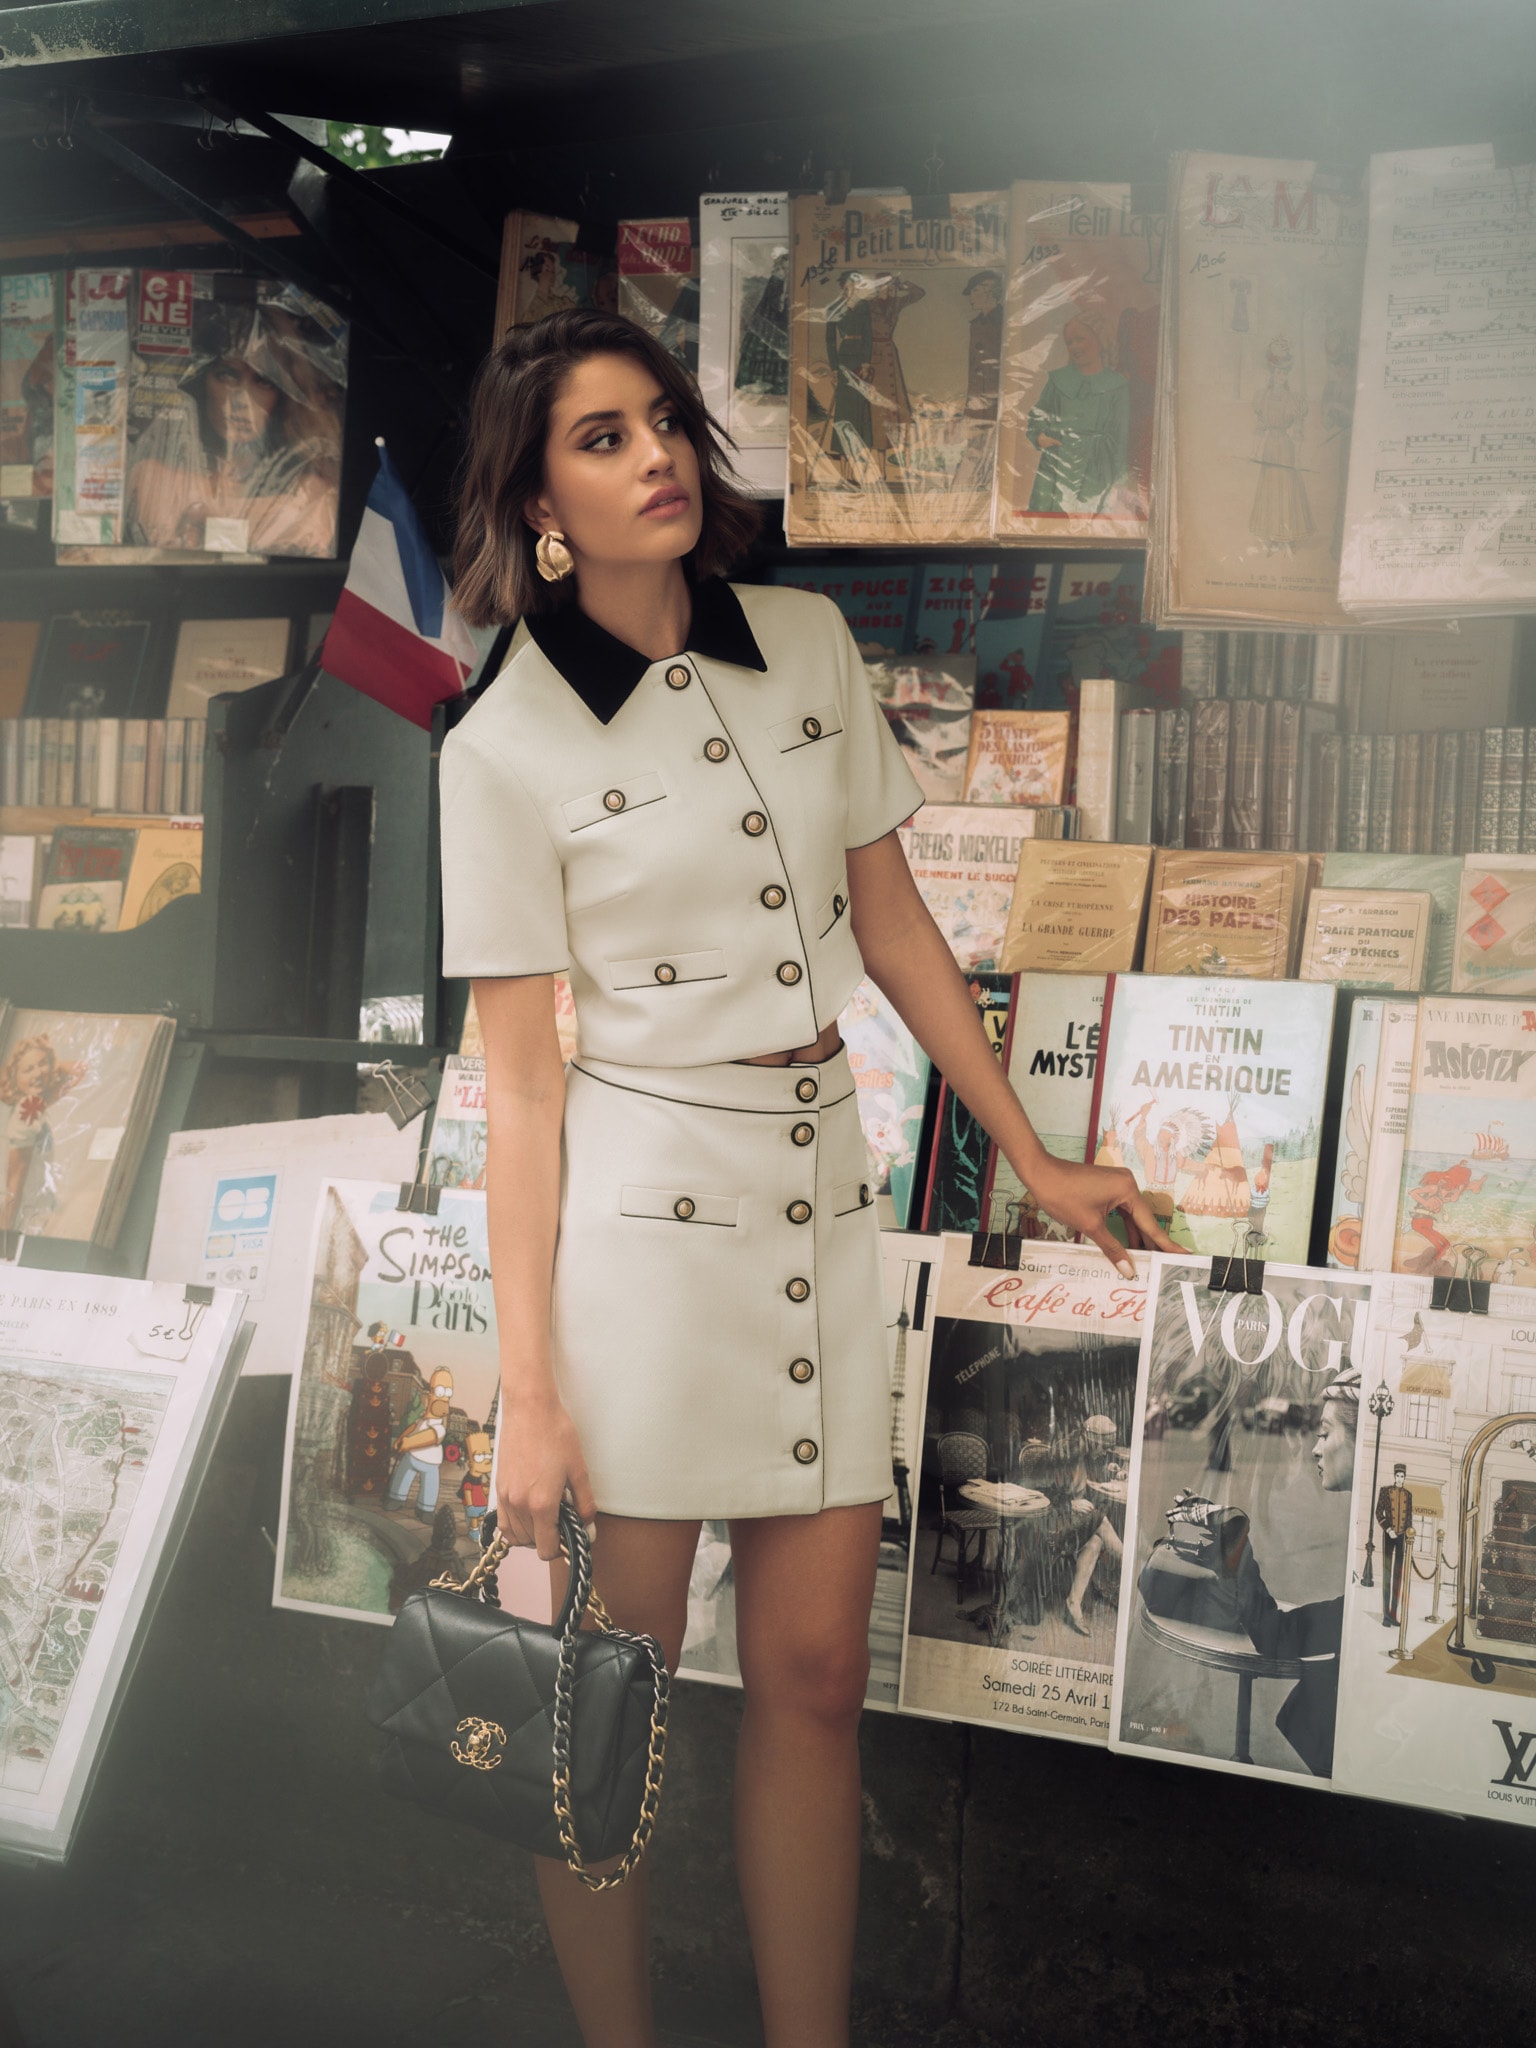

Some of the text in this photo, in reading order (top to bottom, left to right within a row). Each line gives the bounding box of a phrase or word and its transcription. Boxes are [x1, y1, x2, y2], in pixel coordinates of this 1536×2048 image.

[844, 209, 893, 262] Petit
[1190, 251, 1227, 274] 1906
[851, 577, 909, 598] PUCE
[929, 576, 976, 592] ZIG
[1071, 581, 1112, 597] ZIG
[909, 831, 954, 862] PIEDS
[967, 871, 981, 881] LE
[1184, 894, 1258, 910] HISTOIRE
[1162, 907, 1277, 931] DES PAPES
[1021, 921, 1117, 939] LA GRANDE GUERRE
[1357, 926, 1416, 939] PRATIQUE
[1194, 1004, 1242, 1018] TINTIN
[1168, 1024, 1264, 1056] TINTIN
[1204, 1054, 1221, 1064] EN
[458, 1072, 483, 1082] WALT
[1131, 1059, 1292, 1097] AMÉRIQUE
[242, 1238, 264, 1250] VISA
[1020, 1260, 1053, 1274] Saint
[1058, 1263, 1112, 1280] Germain
[10, 1294, 53, 1311] PARIS
[408, 1279, 489, 1335] Paris
[984, 1277, 1070, 1324] Café
[1071, 1296, 1096, 1318] de
[1235, 1318, 1269, 1333] PARIS
[1010, 1657, 1114, 1687] SOIRÉE LITTÉRAIRE
[981, 1674, 1037, 1699] Samedi
[1041, 1683, 1062, 1702] 25
[1064, 1688, 1097, 1709] Avril
[992, 1700, 1010, 1714] 172
[1012, 1703, 1025, 1716] Bd
[1025, 1706, 1089, 1727] Saint-Germain,
[1129, 1720, 1146, 1732] PRIX
[1487, 1789, 1514, 1803] LOUIS
